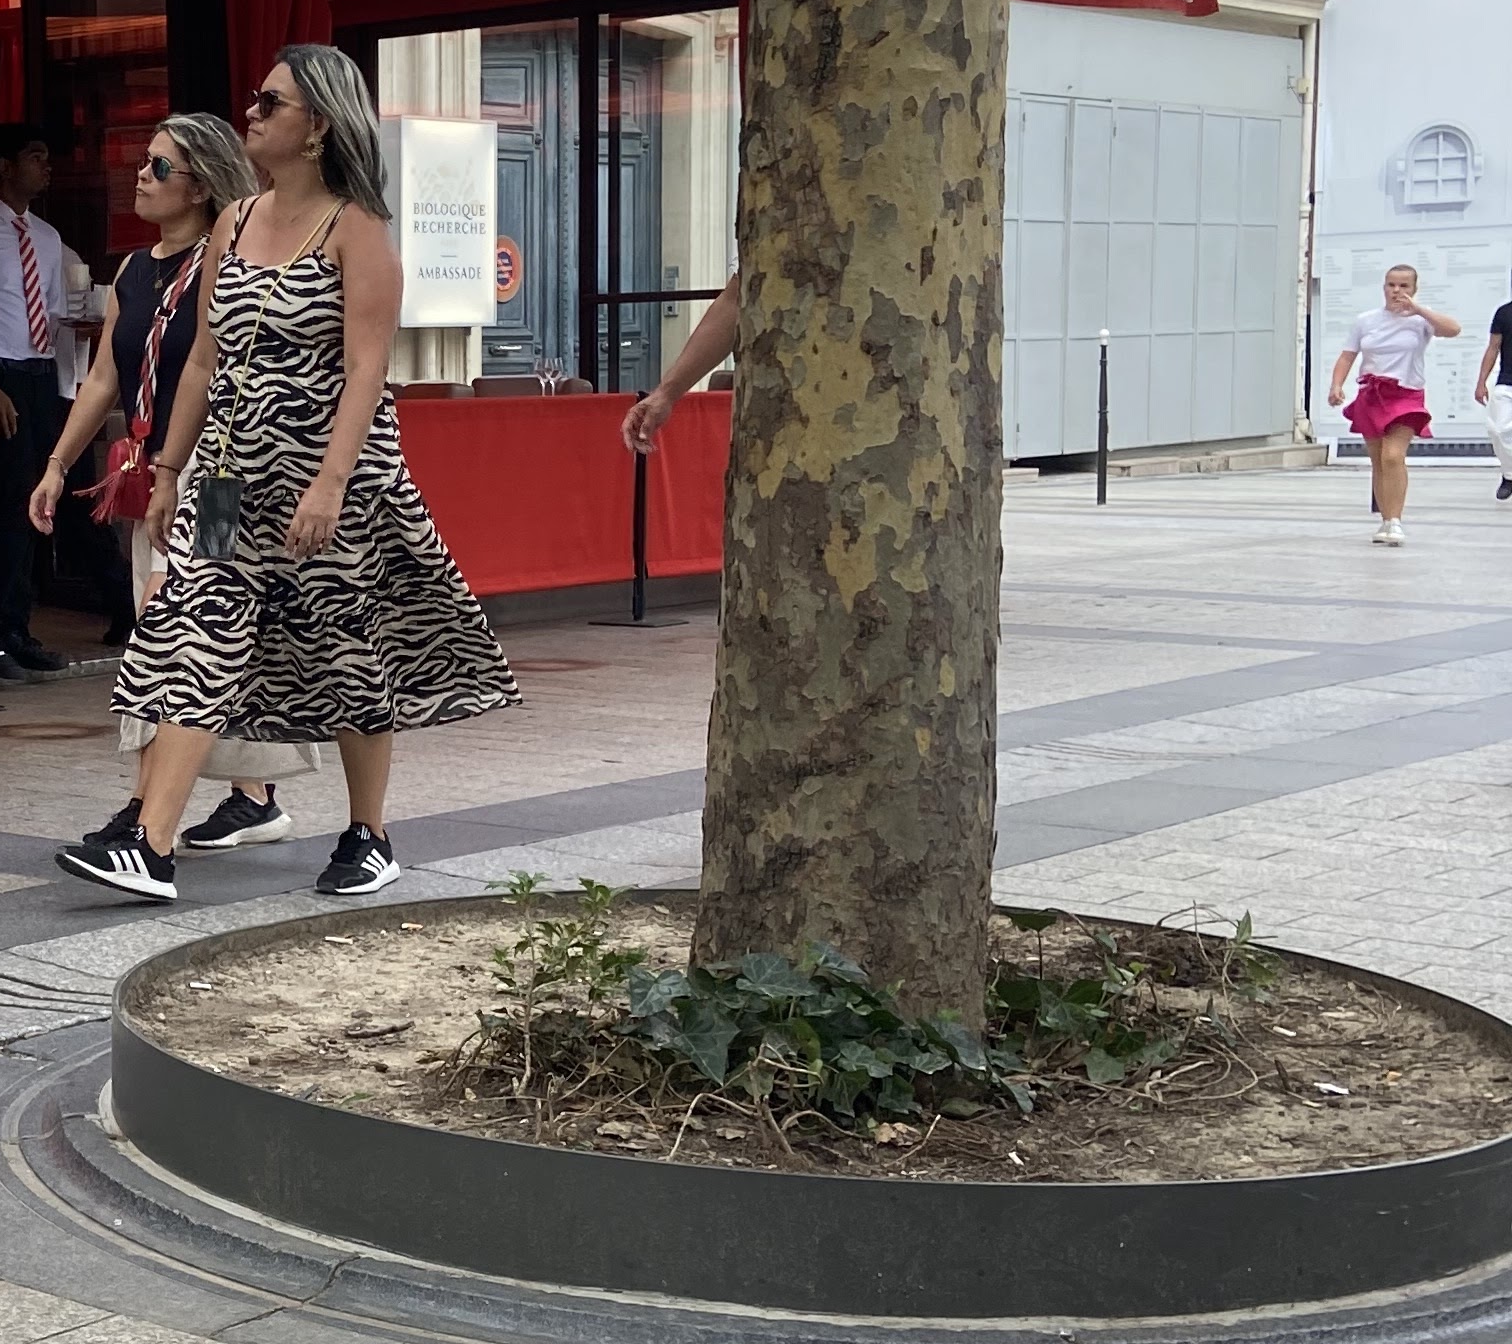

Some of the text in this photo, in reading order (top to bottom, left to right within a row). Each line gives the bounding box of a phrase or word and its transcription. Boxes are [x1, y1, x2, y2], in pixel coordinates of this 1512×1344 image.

[413, 202, 486, 220] BIOLOGIQUE
[413, 220, 486, 235] RECHERCHE
[417, 266, 482, 281] AMBASSADE
